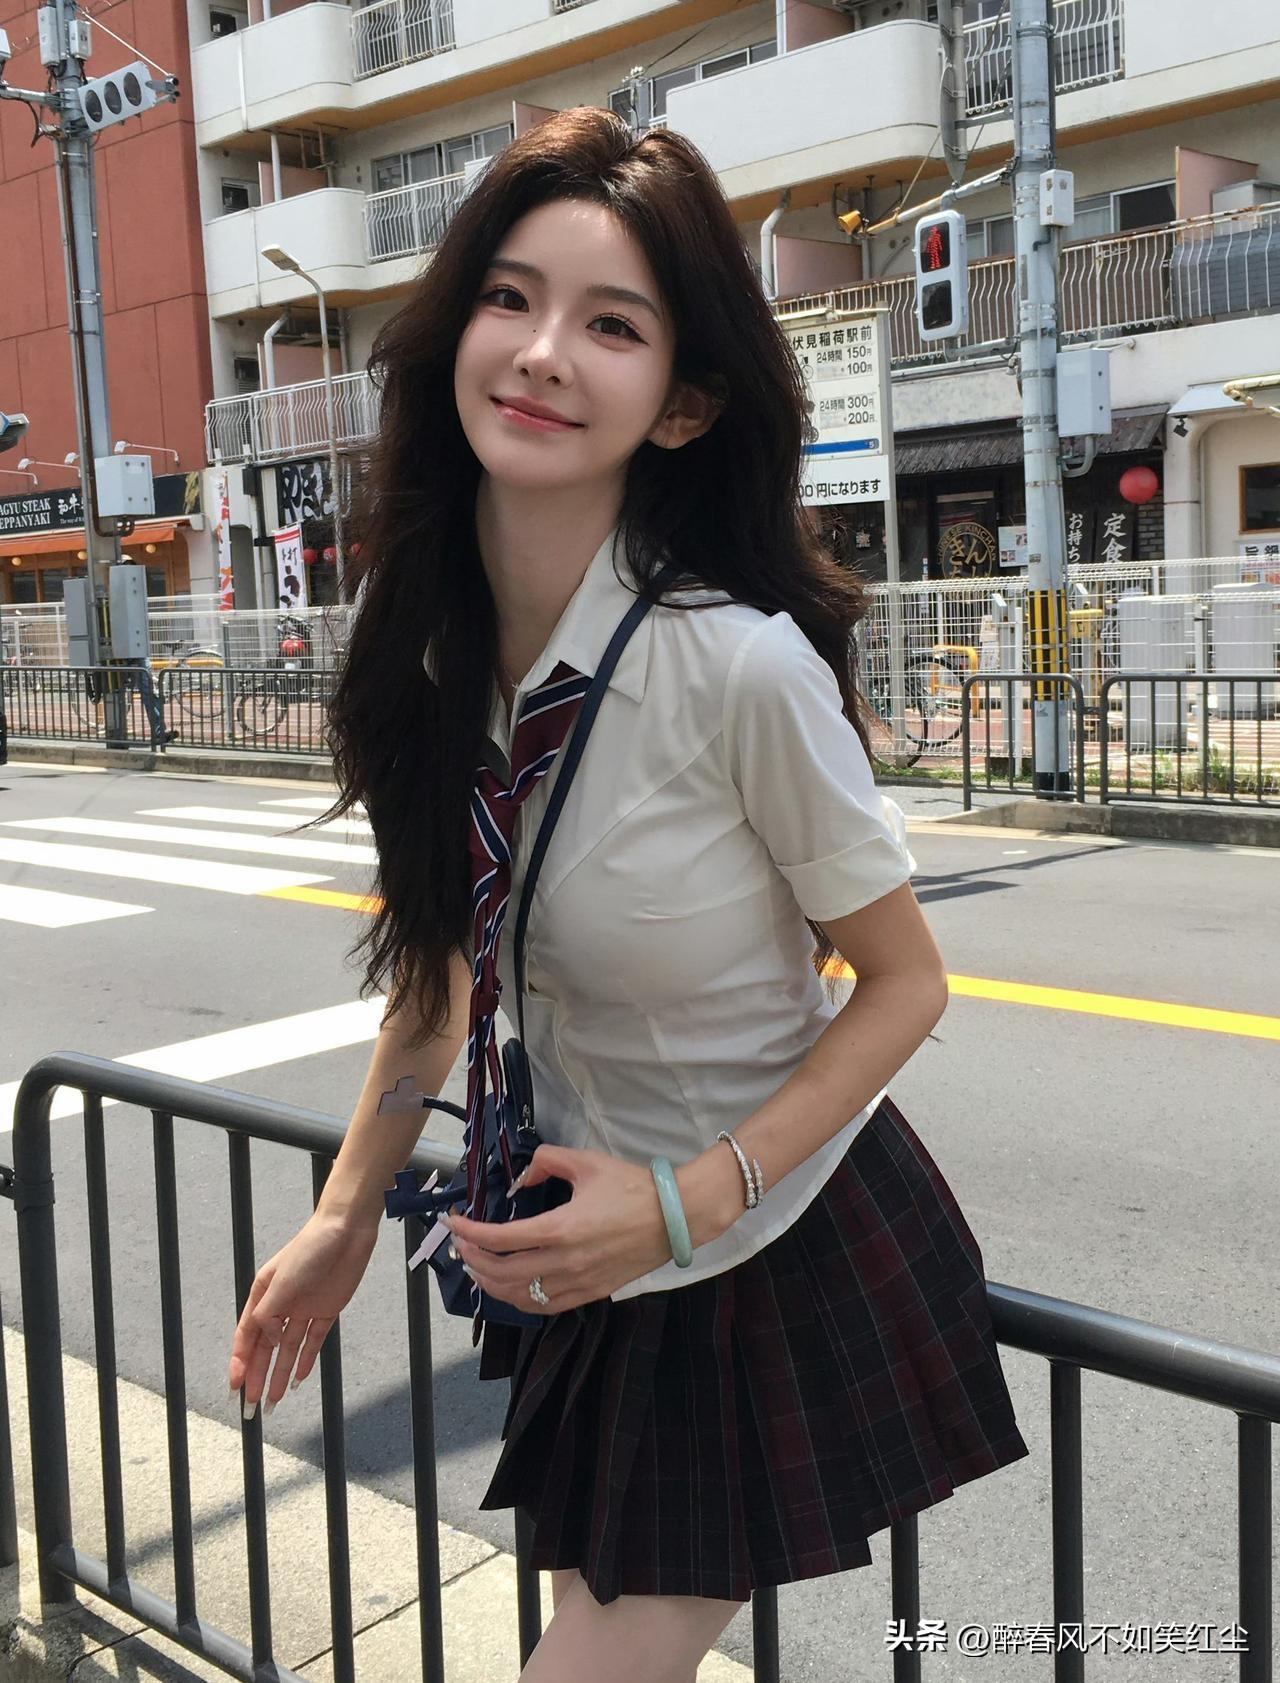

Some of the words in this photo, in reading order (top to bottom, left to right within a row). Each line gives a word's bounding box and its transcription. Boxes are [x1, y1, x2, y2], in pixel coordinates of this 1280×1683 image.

[792, 325, 872, 350] 伏見稲荷駅前
[816, 350, 842, 363] 24時間
[847, 345, 872, 359] 150円
[847, 361, 873, 375] 100円
[820, 399, 845, 412] 24時間
[847, 395, 874, 409] 300円
[848, 411, 875, 424] 200円
[22, 497, 51, 514] STEAK
[964, 525, 998, 561] KINCHAN
[1067, 512, 1083, 563] お持ち
